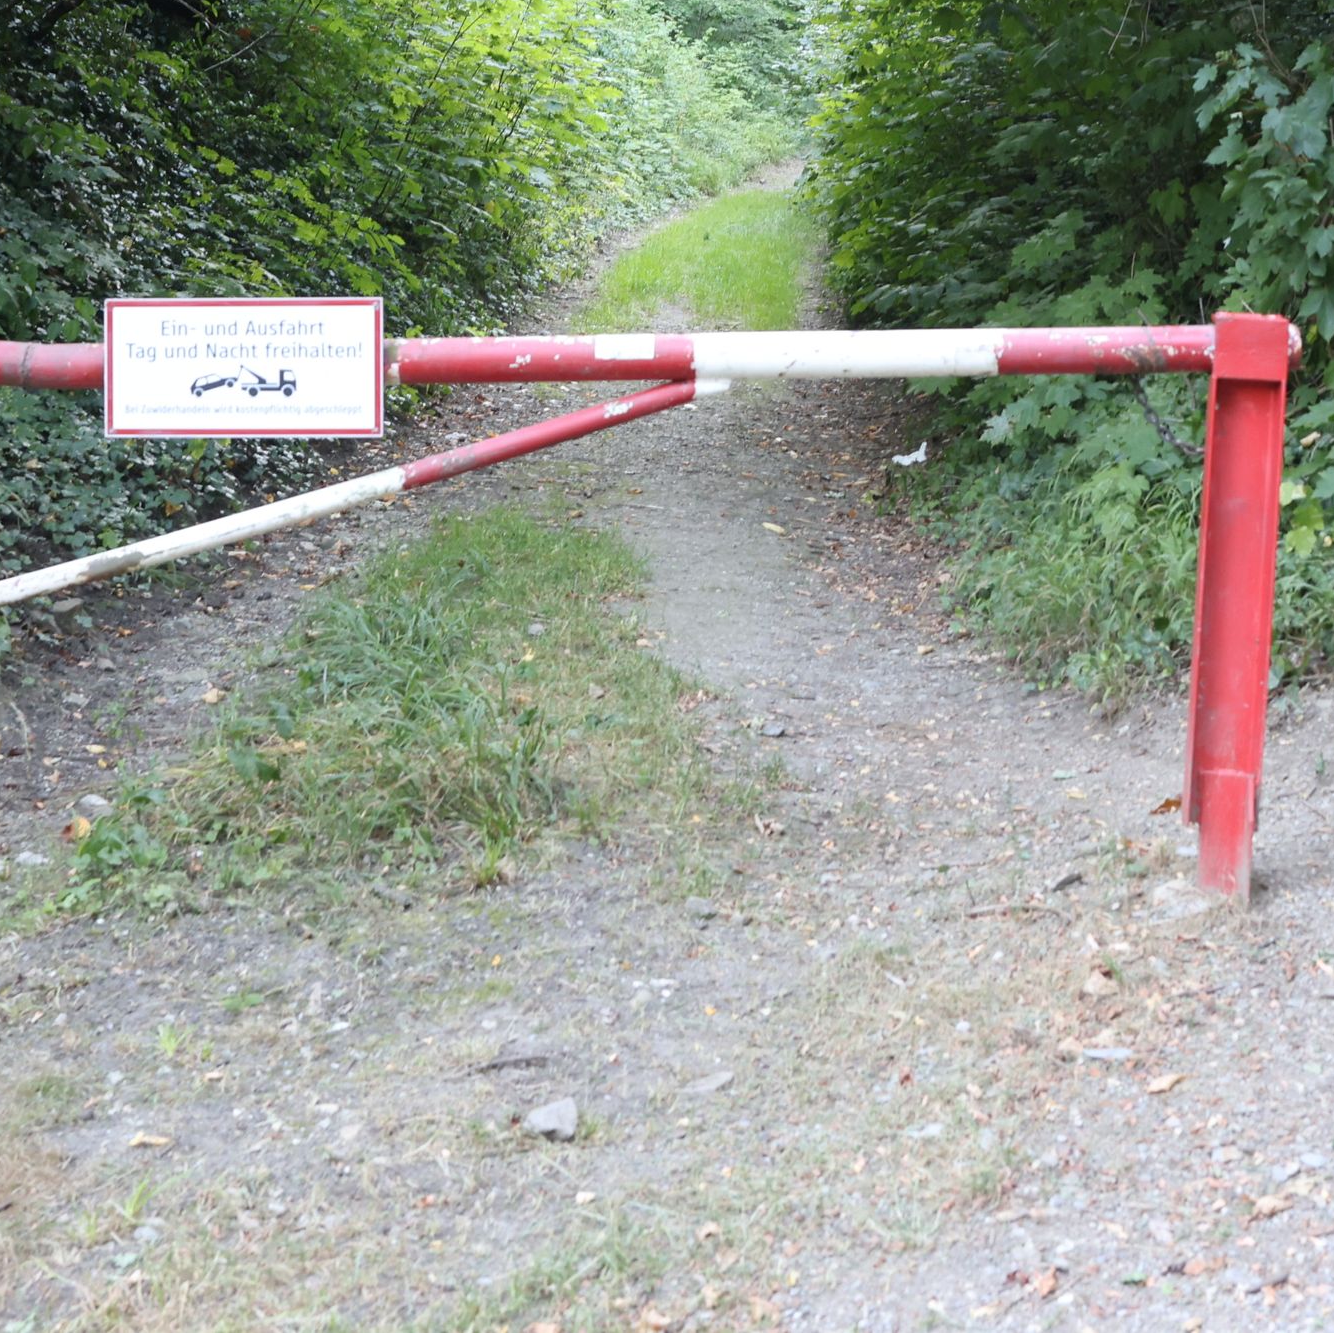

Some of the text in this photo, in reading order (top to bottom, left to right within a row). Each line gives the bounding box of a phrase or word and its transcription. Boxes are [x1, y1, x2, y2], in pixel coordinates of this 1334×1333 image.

[160, 320, 325, 336] Ein- und Ausfahrt
[125, 341, 364, 362] Tag und Nacht freihalten!
[124, 404, 139, 414] Bei
[141, 404, 211, 414] Zuwiderhandeln
[214, 404, 233, 414] wird
[235, 404, 301, 416] kostenpflichtig
